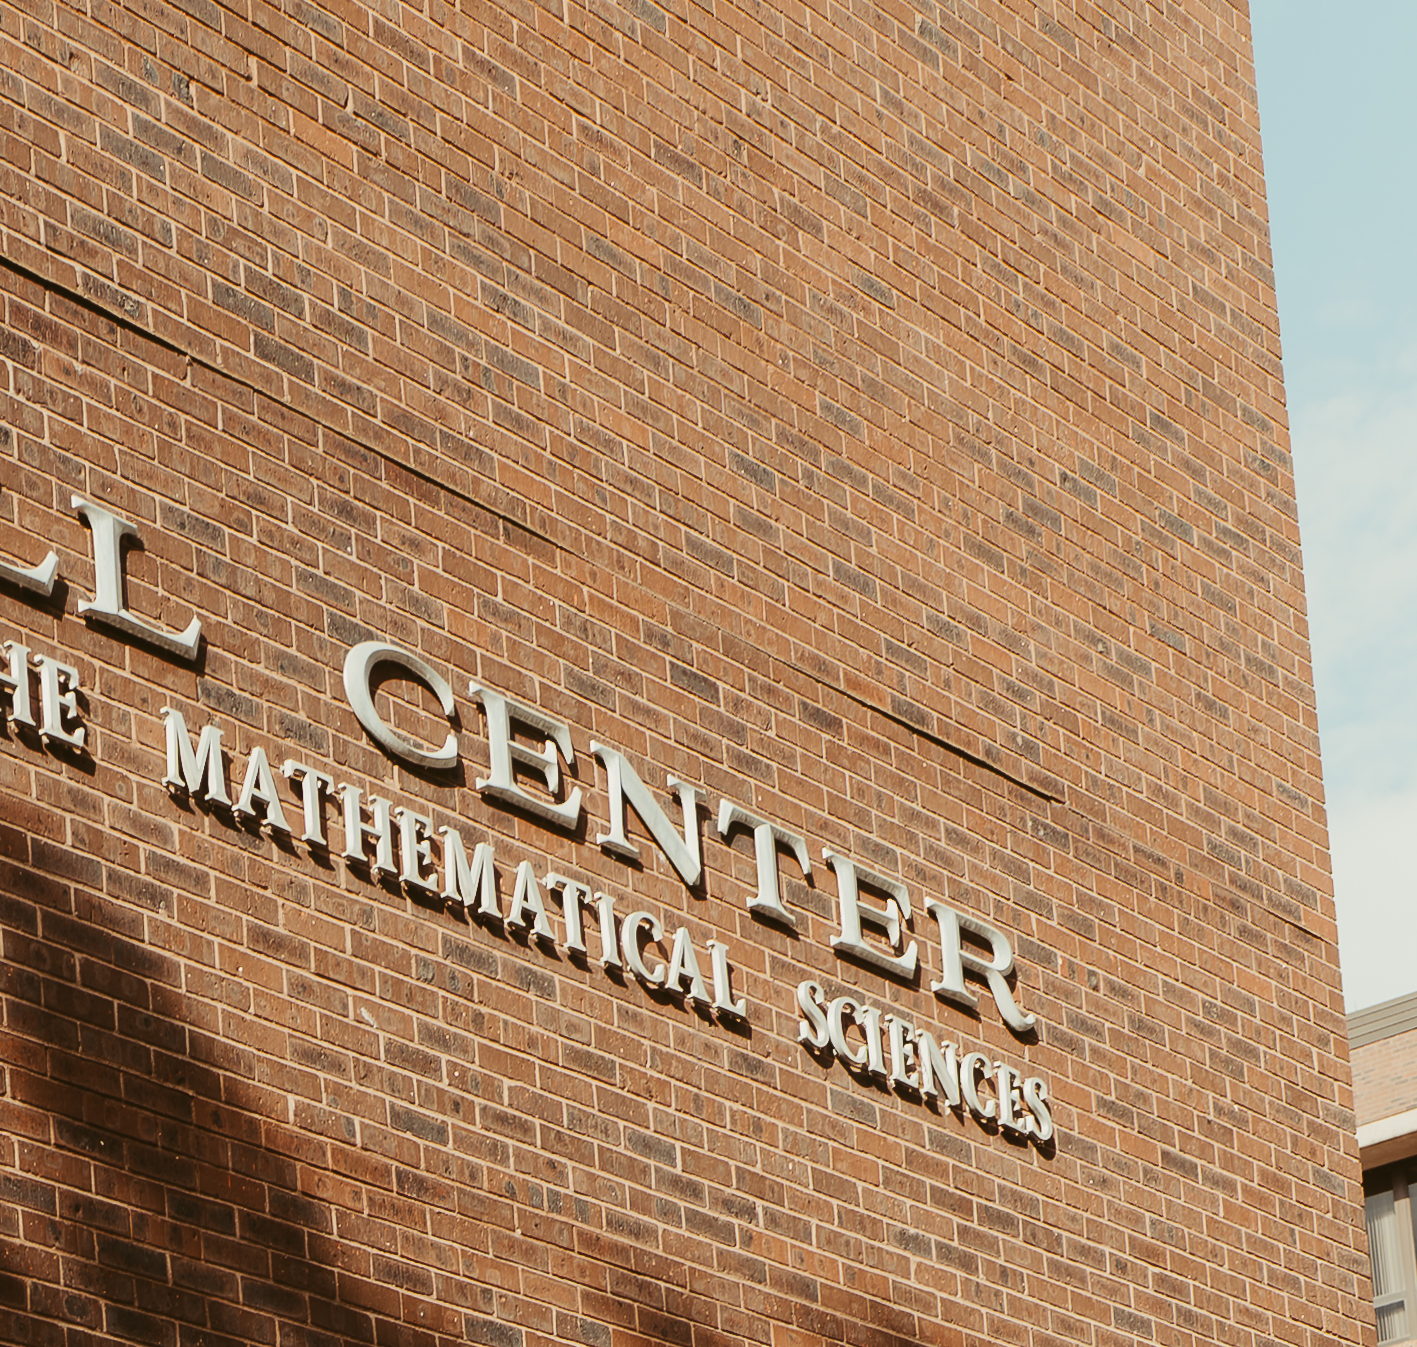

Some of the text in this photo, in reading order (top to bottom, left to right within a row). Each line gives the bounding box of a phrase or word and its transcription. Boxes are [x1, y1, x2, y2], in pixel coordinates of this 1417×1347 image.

[160, 705, 747, 1018] MATHEMATICAL
[797, 980, 1054, 1145] SCIENCES
[343, 640, 1037, 1032] CENTER
